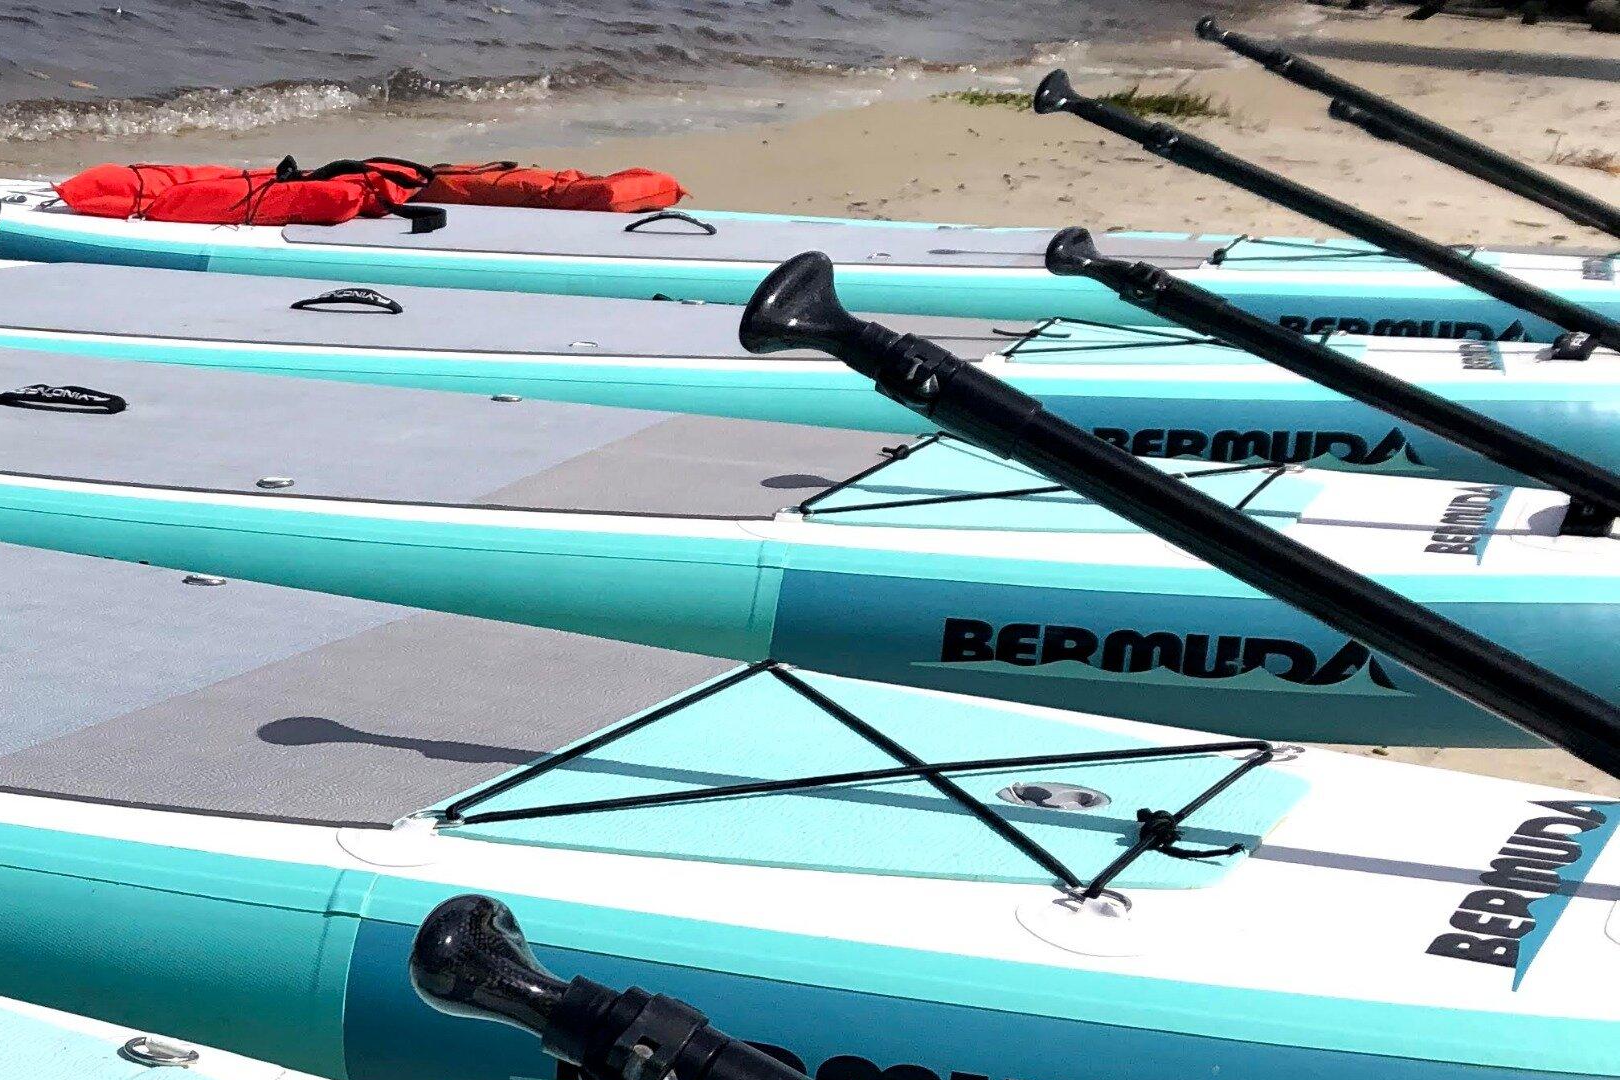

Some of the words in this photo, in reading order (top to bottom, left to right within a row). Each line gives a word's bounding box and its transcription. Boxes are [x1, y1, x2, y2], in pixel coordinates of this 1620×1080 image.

[1093, 426, 1425, 466] BERMUDA
[941, 618, 1396, 688] BERMUDA
[1425, 800, 1620, 968] BERMUDA
